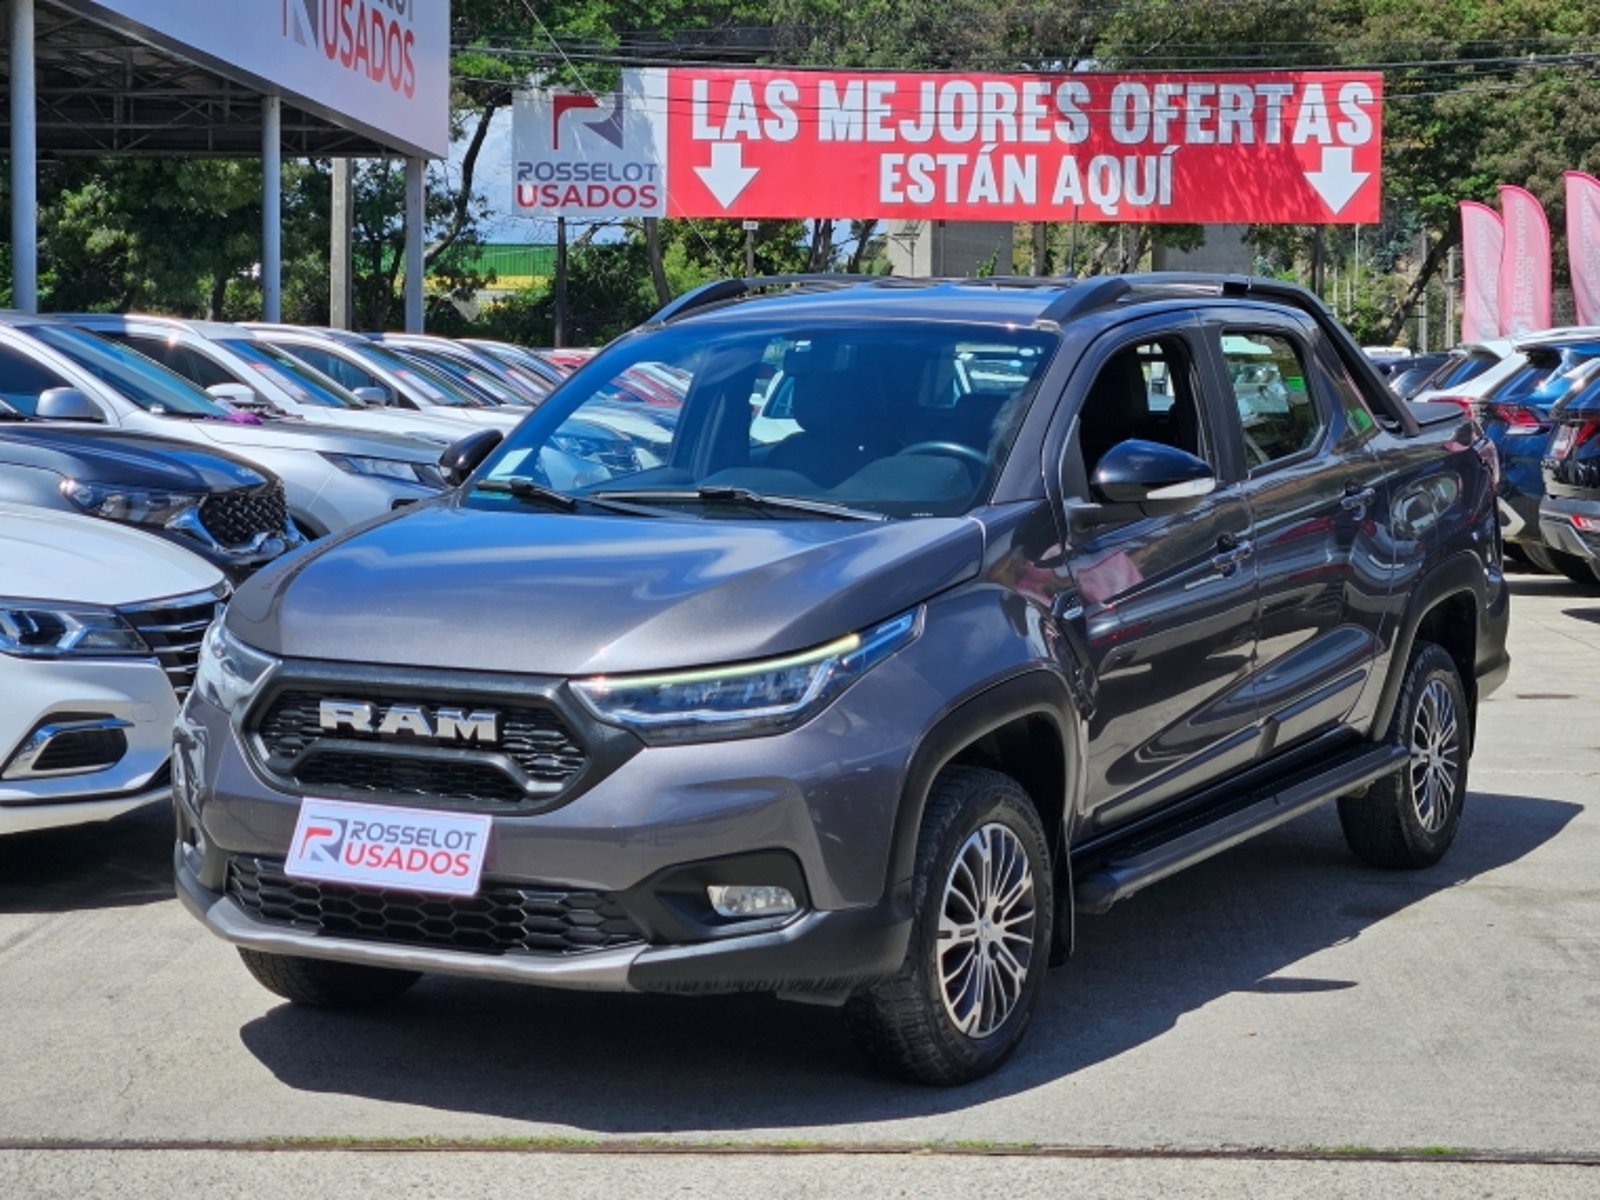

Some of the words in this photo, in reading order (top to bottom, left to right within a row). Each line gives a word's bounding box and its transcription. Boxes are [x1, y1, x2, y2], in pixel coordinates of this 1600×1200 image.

[322, 0, 416, 99] USADOS
[692, 79, 799, 141] LAS
[818, 80, 1091, 144] MEJORES
[1109, 81, 1374, 145] OFERTAS
[517, 162, 658, 182] ROSSELOT
[879, 143, 1036, 205] ESTÁN
[1051, 145, 1180, 216] AQUÍ
[517, 184, 658, 209] USADOS
[319, 699, 499, 742] RAM
[350, 821, 477, 851] ROSSELOT
[344, 843, 472, 876] USADOS
